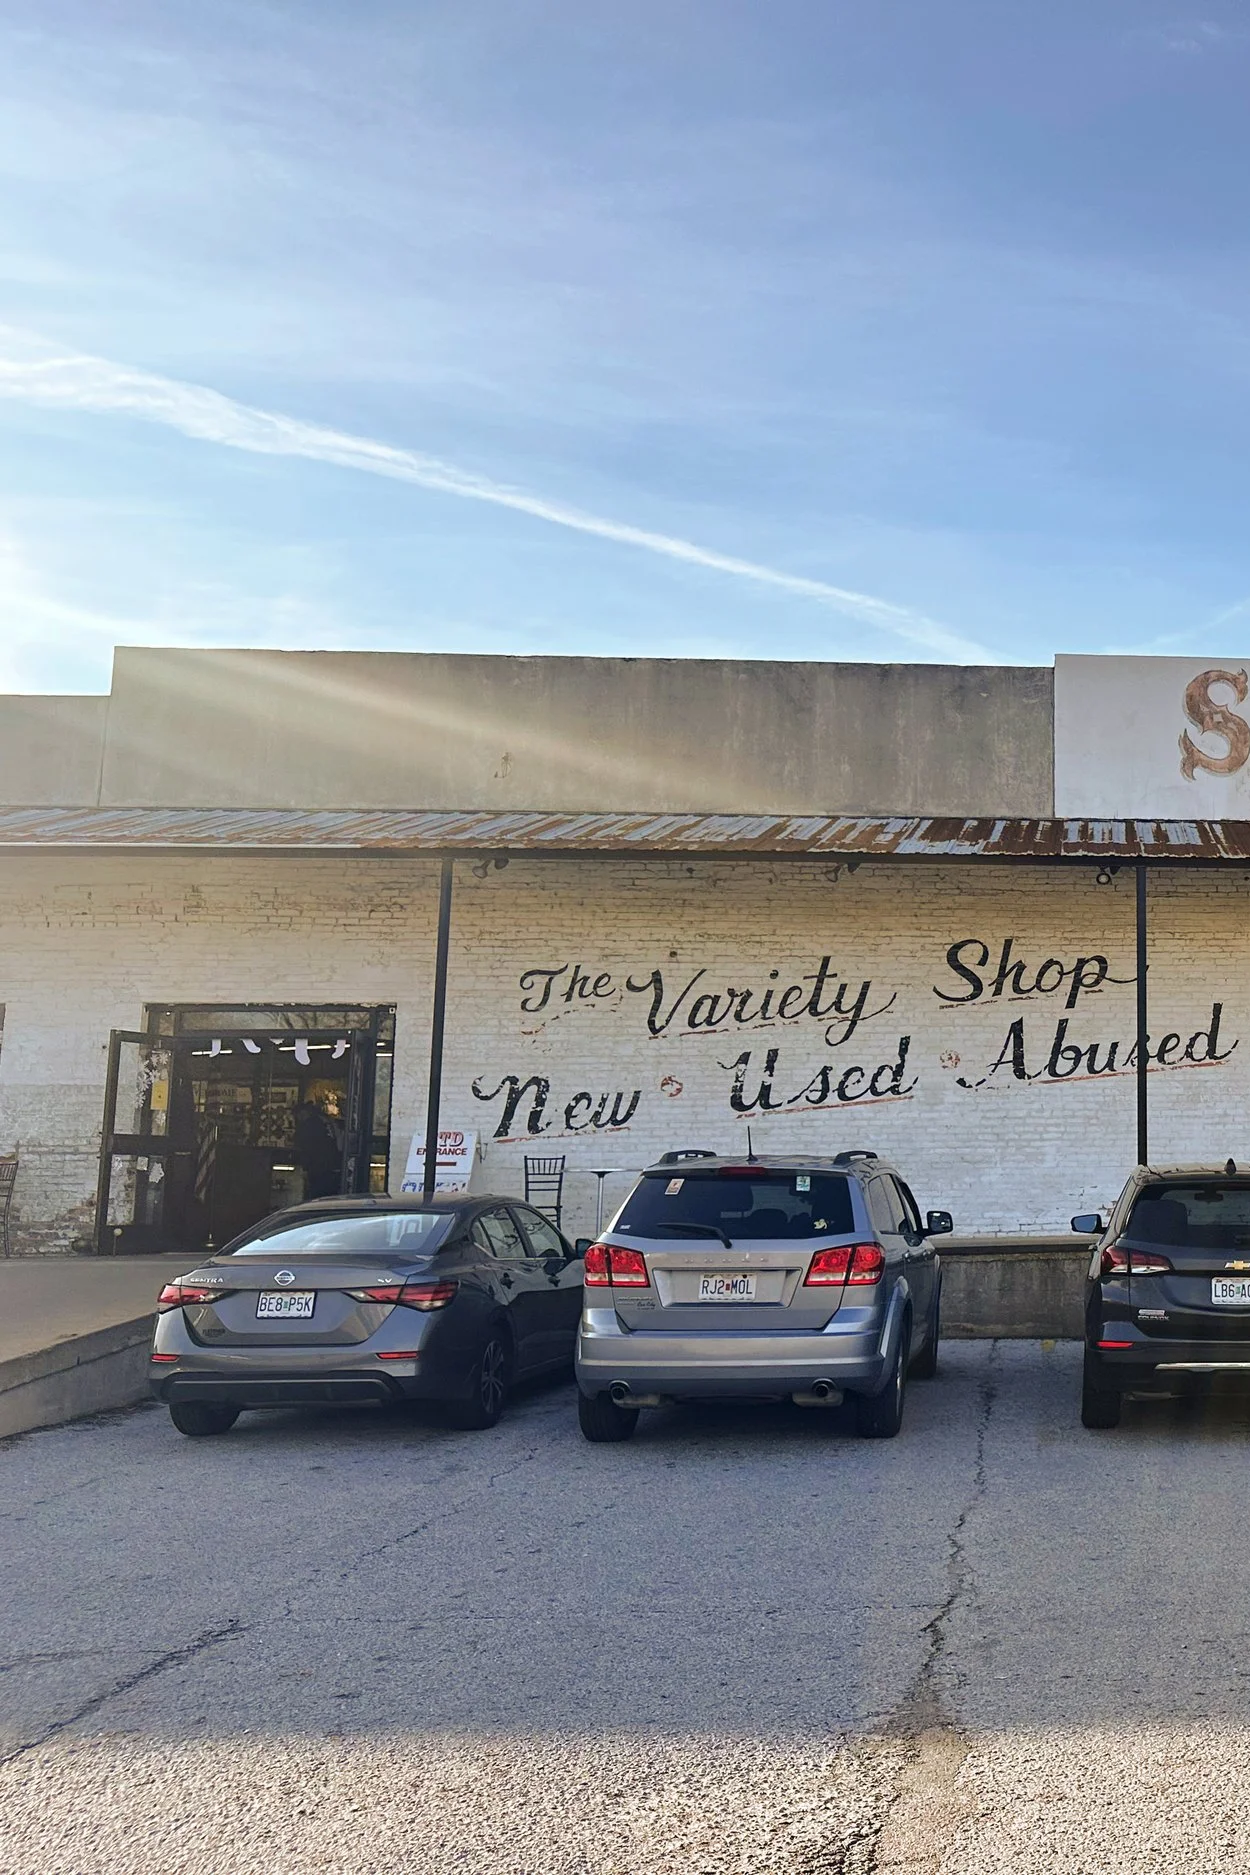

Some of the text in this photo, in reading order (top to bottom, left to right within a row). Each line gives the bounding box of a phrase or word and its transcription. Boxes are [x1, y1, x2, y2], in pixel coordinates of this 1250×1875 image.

[519, 938, 1150, 1047] The Variety Shop
[471, 1002, 1240, 1138] New Used Abused
[416, 1147, 468, 1156] ENRANCE
[701, 1279, 725, 1295] RJ2
[1213, 1283, 1235, 1298] LB6
[259, 1296, 313, 1312] BE8 P5K
